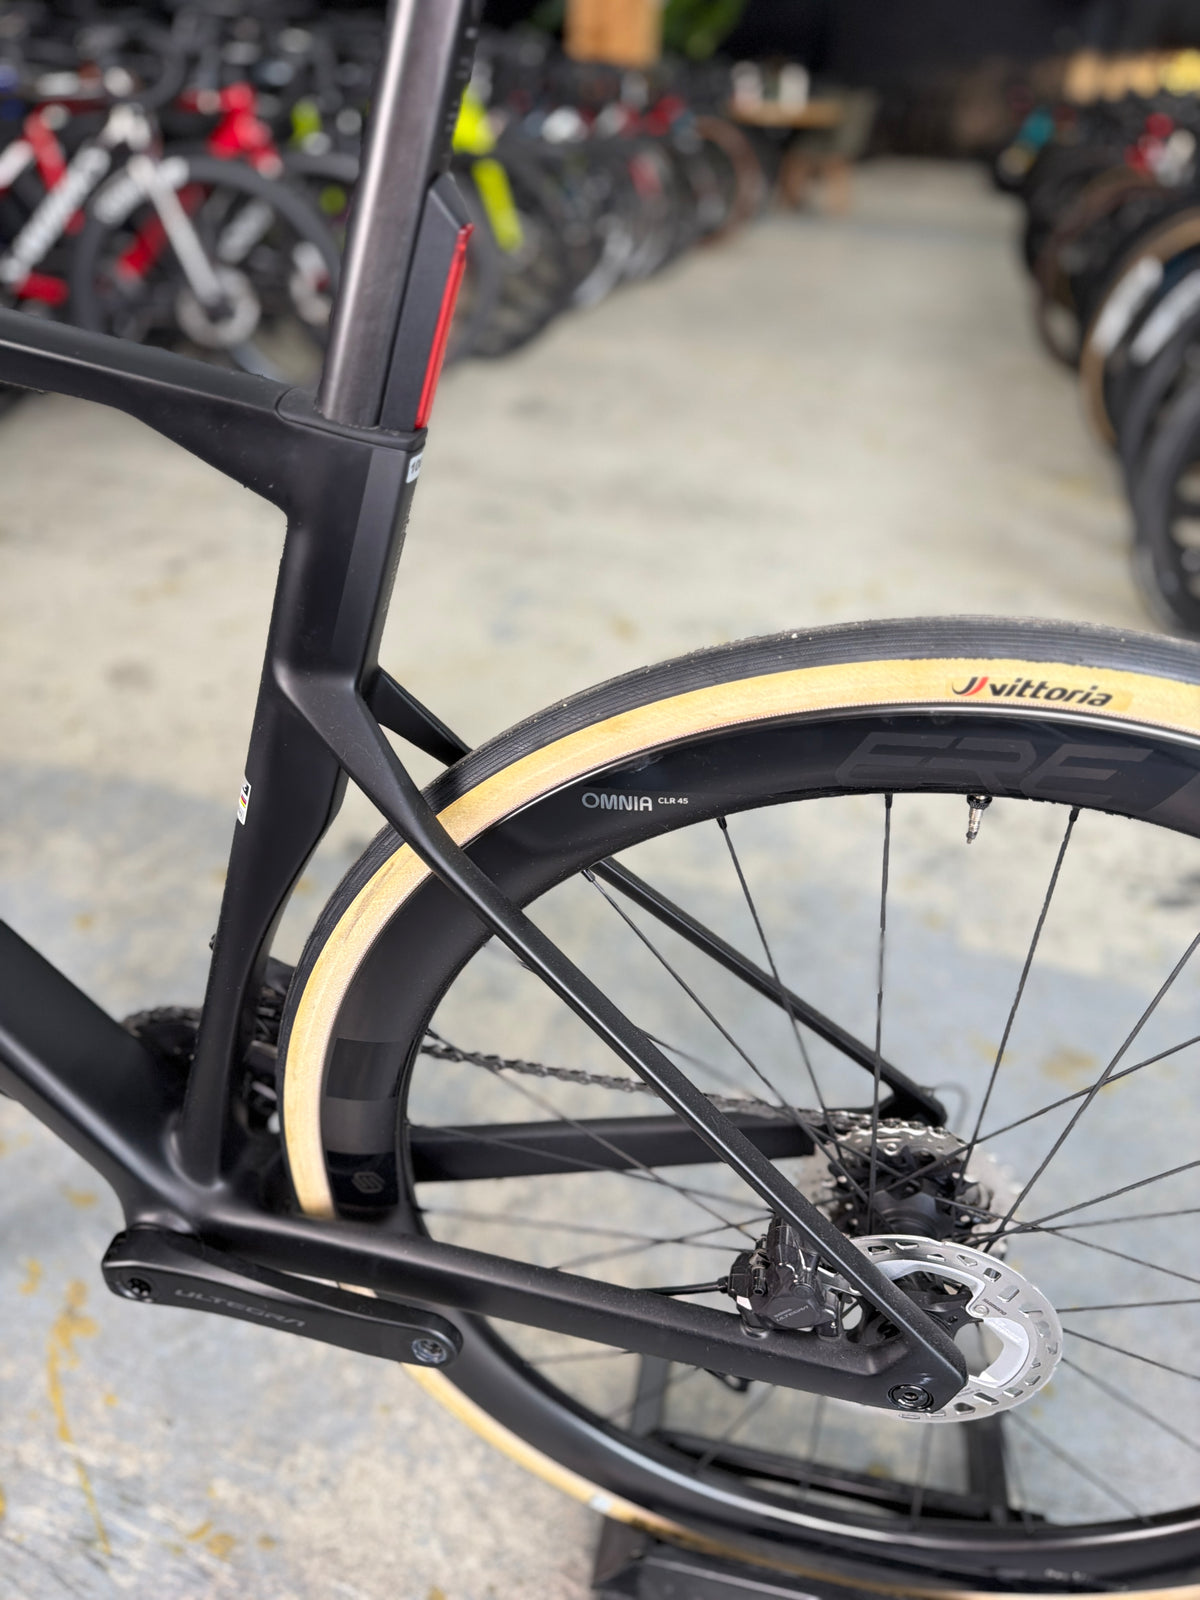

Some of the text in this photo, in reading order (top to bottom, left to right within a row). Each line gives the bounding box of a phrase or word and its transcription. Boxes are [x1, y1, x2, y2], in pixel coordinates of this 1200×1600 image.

[989, 677, 1113, 707] vittoria
[835, 732, 1154, 799] ERE
[581, 792, 689, 812] OMNIA CLR 45
